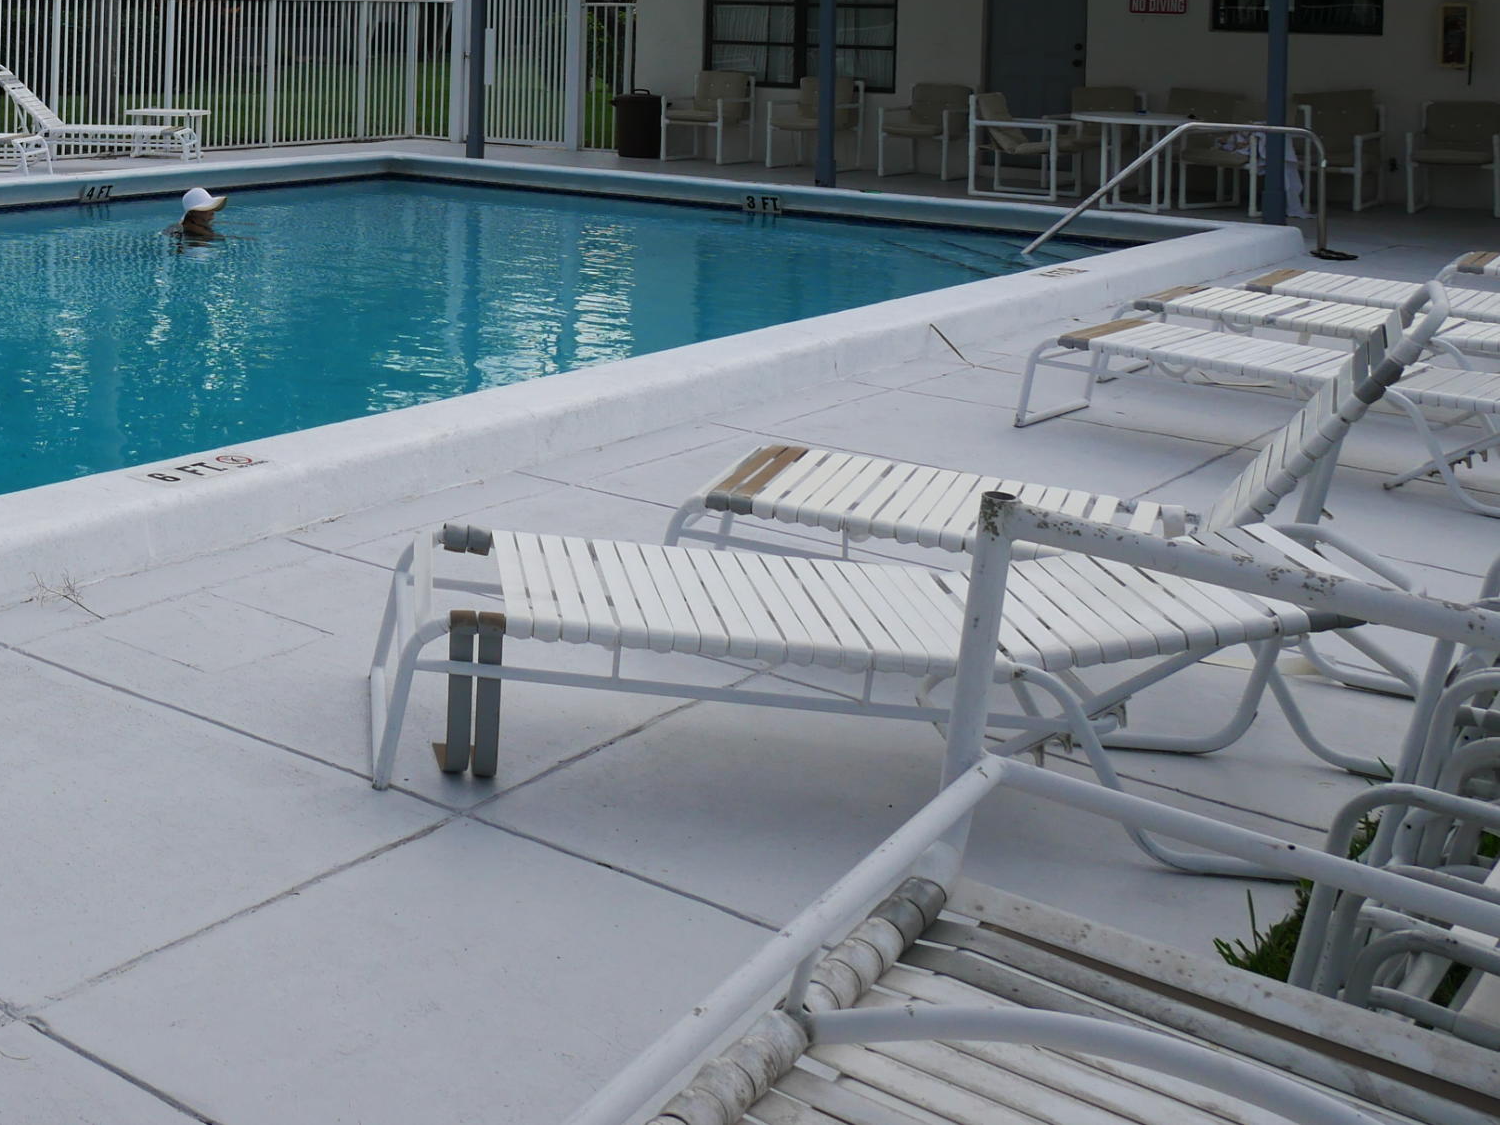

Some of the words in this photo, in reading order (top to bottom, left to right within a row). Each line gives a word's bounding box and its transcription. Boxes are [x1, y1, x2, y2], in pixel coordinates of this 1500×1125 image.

[86, 186, 95, 200] 4
[746, 195, 756, 210] 3
[147, 473, 181, 482] 6
